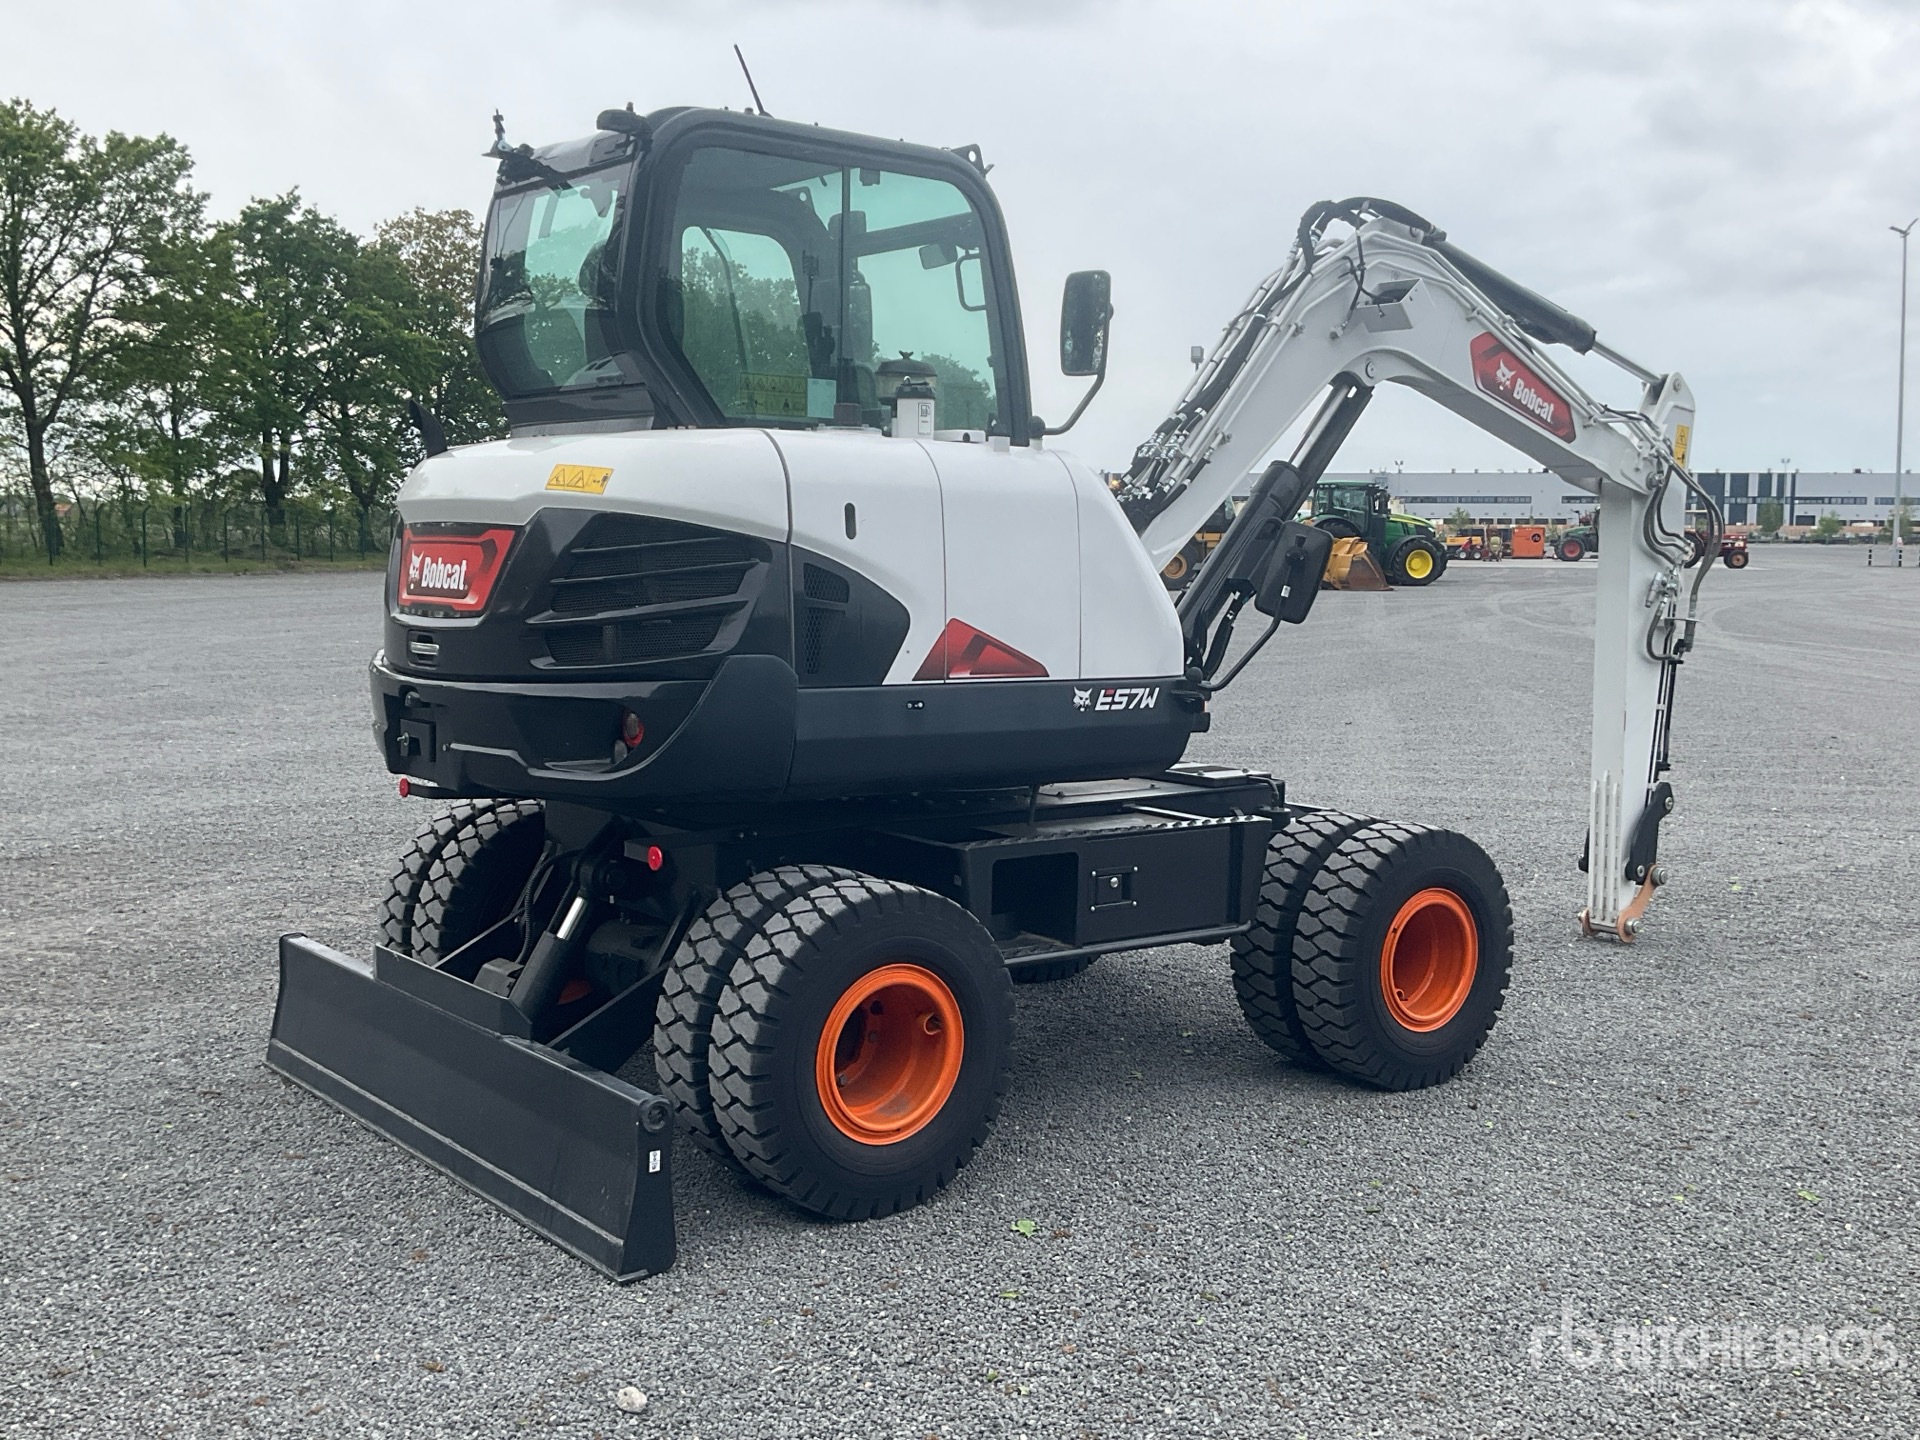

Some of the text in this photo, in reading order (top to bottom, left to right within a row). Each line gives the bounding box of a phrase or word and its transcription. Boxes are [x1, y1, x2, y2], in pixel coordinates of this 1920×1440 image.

[1513, 378, 1554, 422] Bobcat
[421, 557, 467, 590] Bobcat
[1094, 687, 1160, 711] E57W
